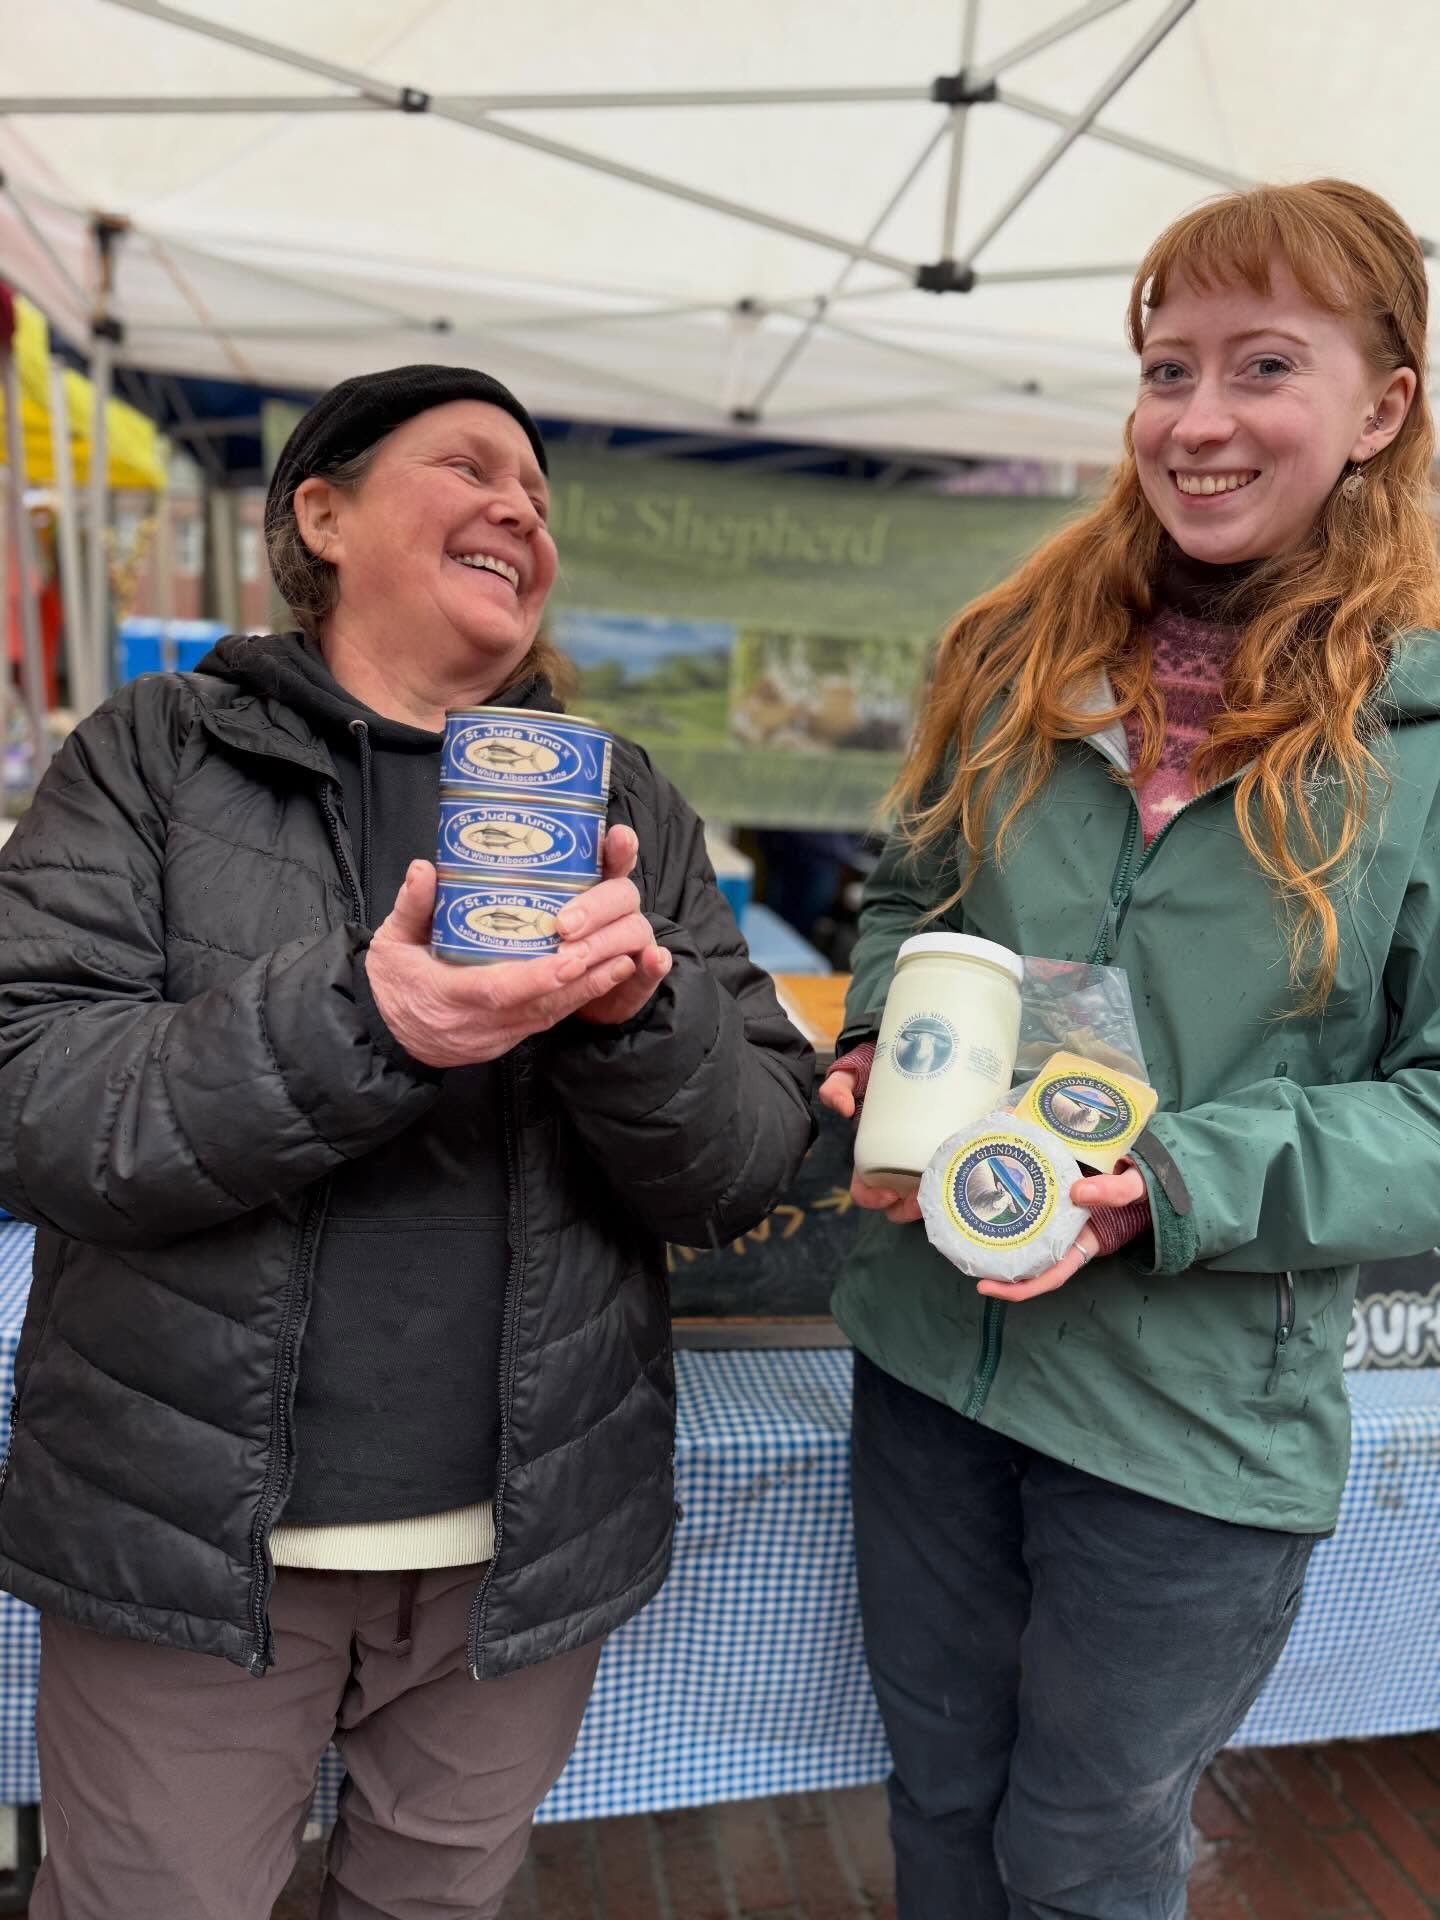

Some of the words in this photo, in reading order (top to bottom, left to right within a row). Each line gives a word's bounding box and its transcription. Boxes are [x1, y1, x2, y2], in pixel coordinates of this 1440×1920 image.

[633, 496, 890, 570] Shepherd
[465, 730, 482, 742] St.
[485, 727, 523, 739] Jude
[526, 730, 562, 751] Tuna
[459, 758, 475, 772] Solid
[476, 768, 500, 780] White
[501, 773, 544, 783] Albacore
[547, 770, 567, 781] Tuna
[459, 814, 476, 826] St.
[477, 810, 517, 822] Jude
[520, 813, 555, 833] Tuna
[453, 842, 469, 856] Solid
[470, 851, 495, 863] White
[497, 856, 538, 865] Albacore
[541, 851, 562, 862] Tuna
[464, 896, 483, 909] St.
[486, 894, 527, 906] Jude
[457, 924, 477, 939] Solid
[479, 934, 505, 947] White
[506, 939, 548, 949] Albacore
[549, 936, 562, 946] Tu
[1046, 1078, 1095, 1095] GLENDALE
[1095, 1080, 1128, 1121] SHEPHERD
[1023, 1140, 1044, 1160] White
[1041, 1158, 1052, 1176] Cap
[959, 1159, 975, 1200] FARMSTEAD
[976, 1145, 1032, 1166] GLENDALE
[1026, 1163, 1044, 1223] SHEPHERD
[959, 1199, 979, 1225] SHEEP'S
[978, 1222, 997, 1233] MILK
[996, 1221, 1025, 1234] CHEESE
